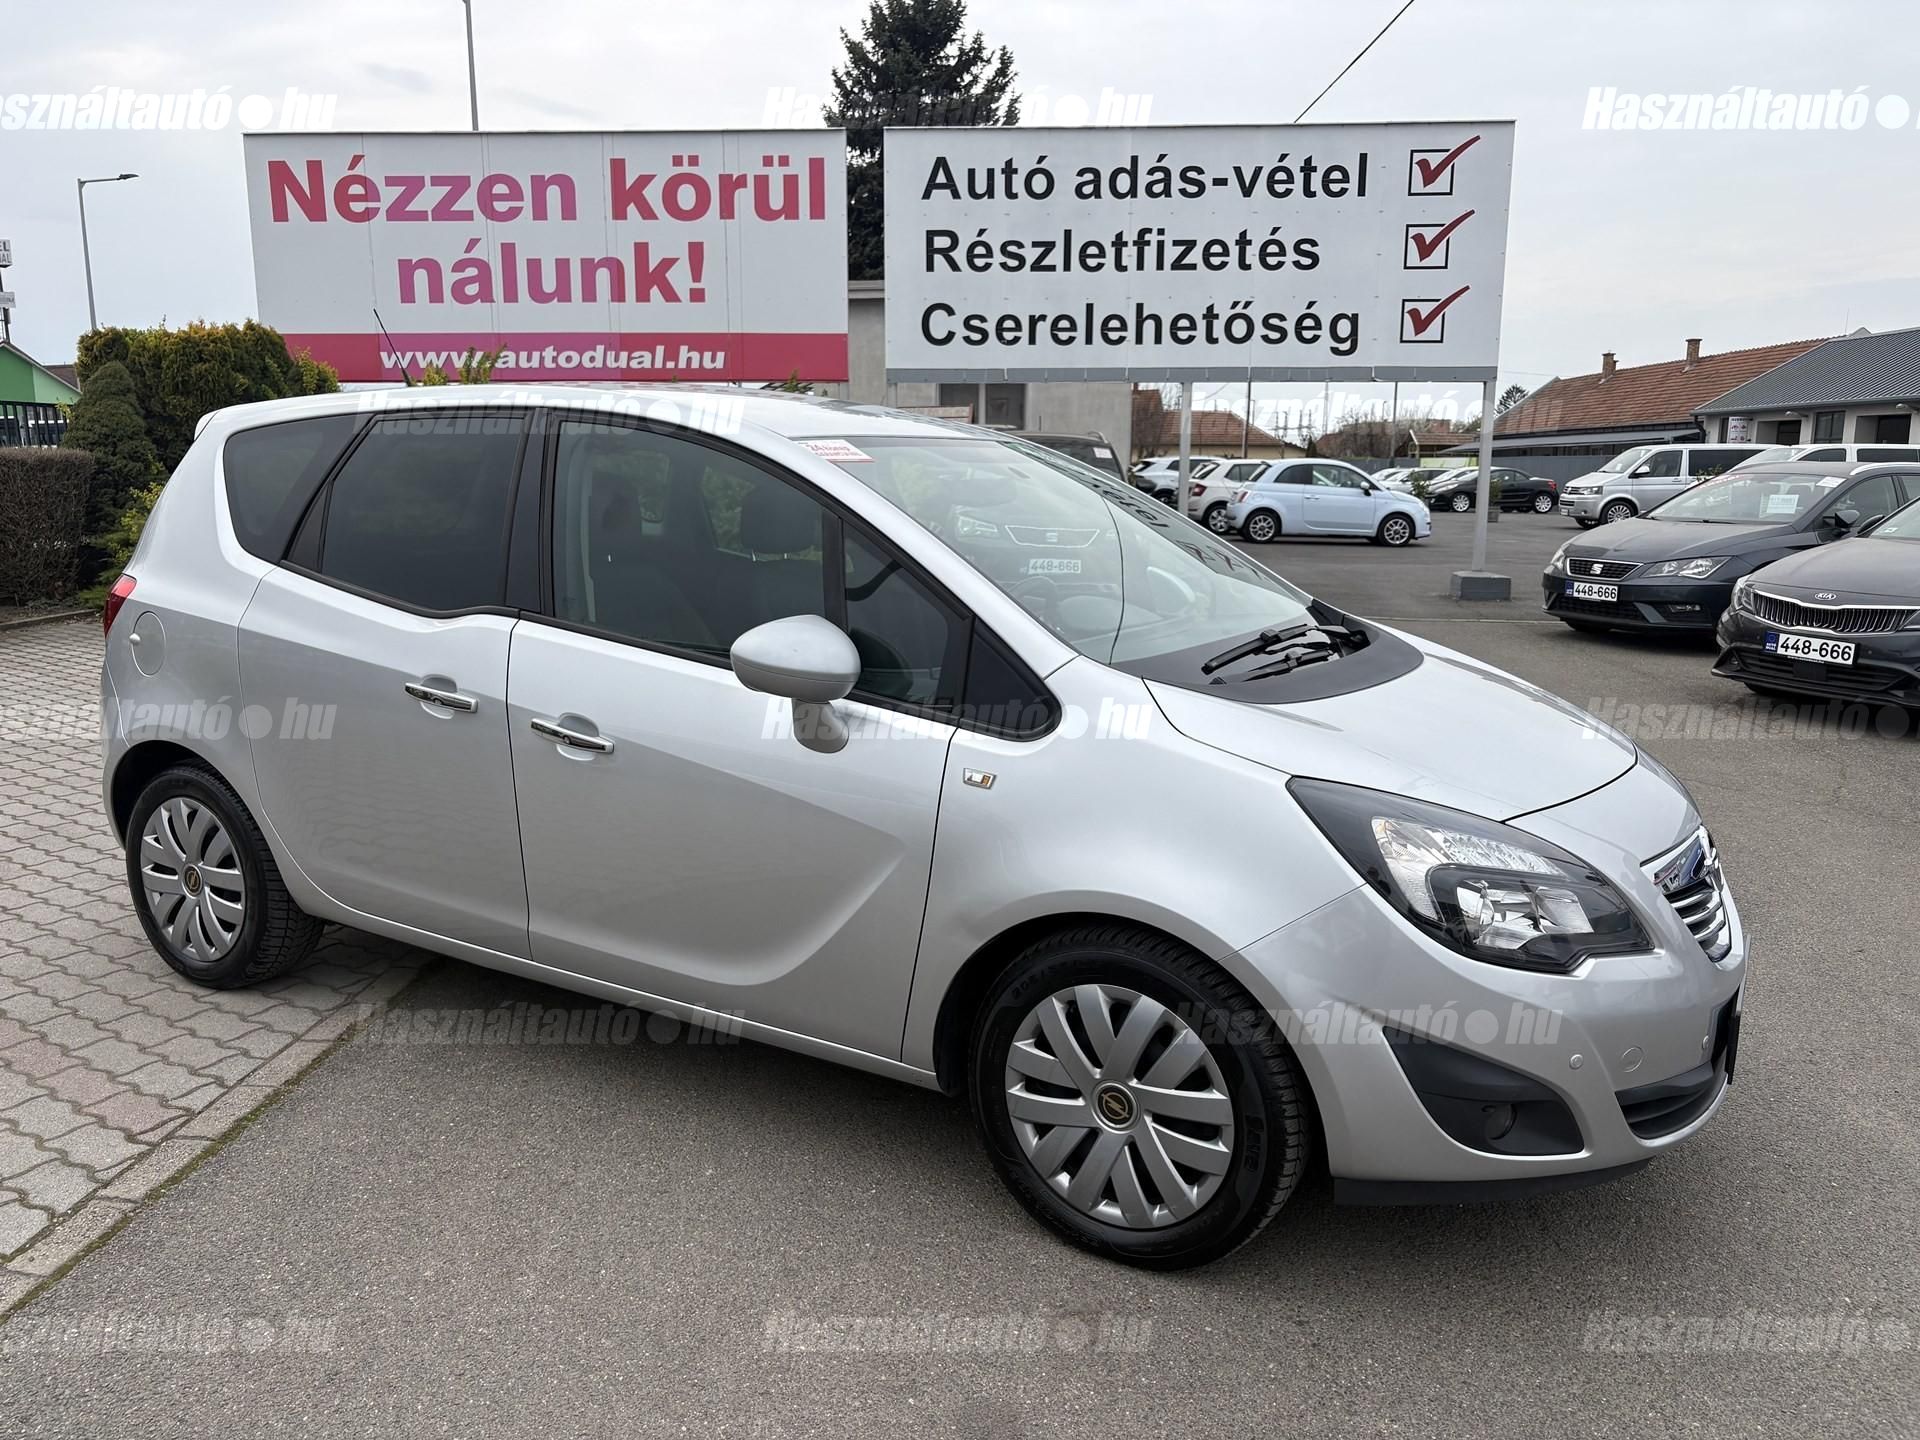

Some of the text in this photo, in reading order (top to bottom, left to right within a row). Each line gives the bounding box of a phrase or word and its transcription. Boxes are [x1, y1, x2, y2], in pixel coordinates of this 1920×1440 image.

[268, 154, 825, 223] Nézzen körül
[921, 153, 1368, 200] Autó adás-vétel
[397, 238, 706, 305] nálunk!
[925, 227, 1320, 273] Részletfizetés
[921, 300, 1359, 356] Cserelehetőség
[1574, 583, 1617, 599] 448-666
[1780, 636, 1852, 661] 448-666
